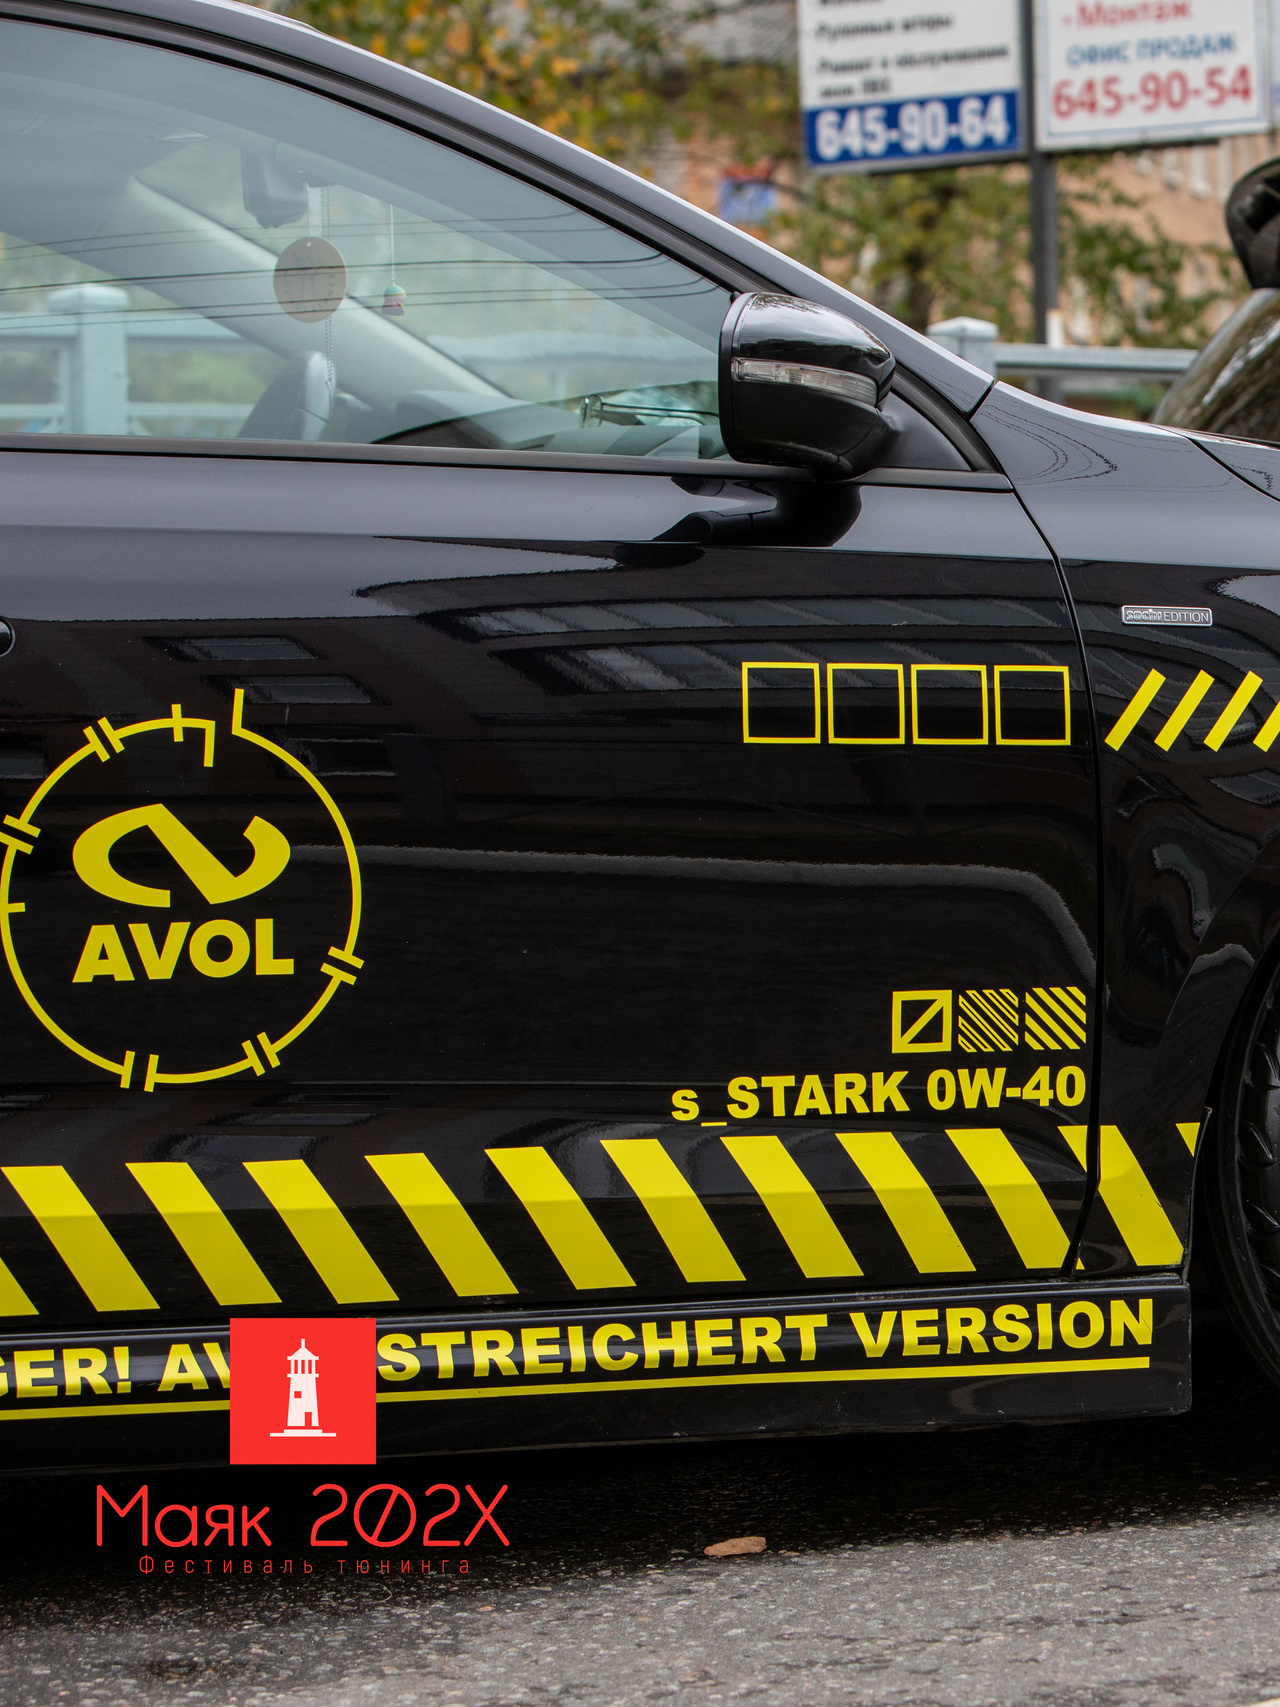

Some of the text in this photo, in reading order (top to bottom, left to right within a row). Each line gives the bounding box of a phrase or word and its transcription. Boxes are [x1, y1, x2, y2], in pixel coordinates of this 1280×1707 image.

[1066, 32, 1236, 67] ОФИС ПРОДАЖ
[1052, 63, 1252, 120] 645-90-54
[815, 94, 1009, 160] 645-90-64
[1163, 611, 1210, 623] EDITION
[72, 918, 294, 982] AVOL
[926, 1065, 1087, 1111] 0W-40
[376, 1313, 828, 1382] STREICHERT
[850, 1298, 1154, 1358] VERSION
